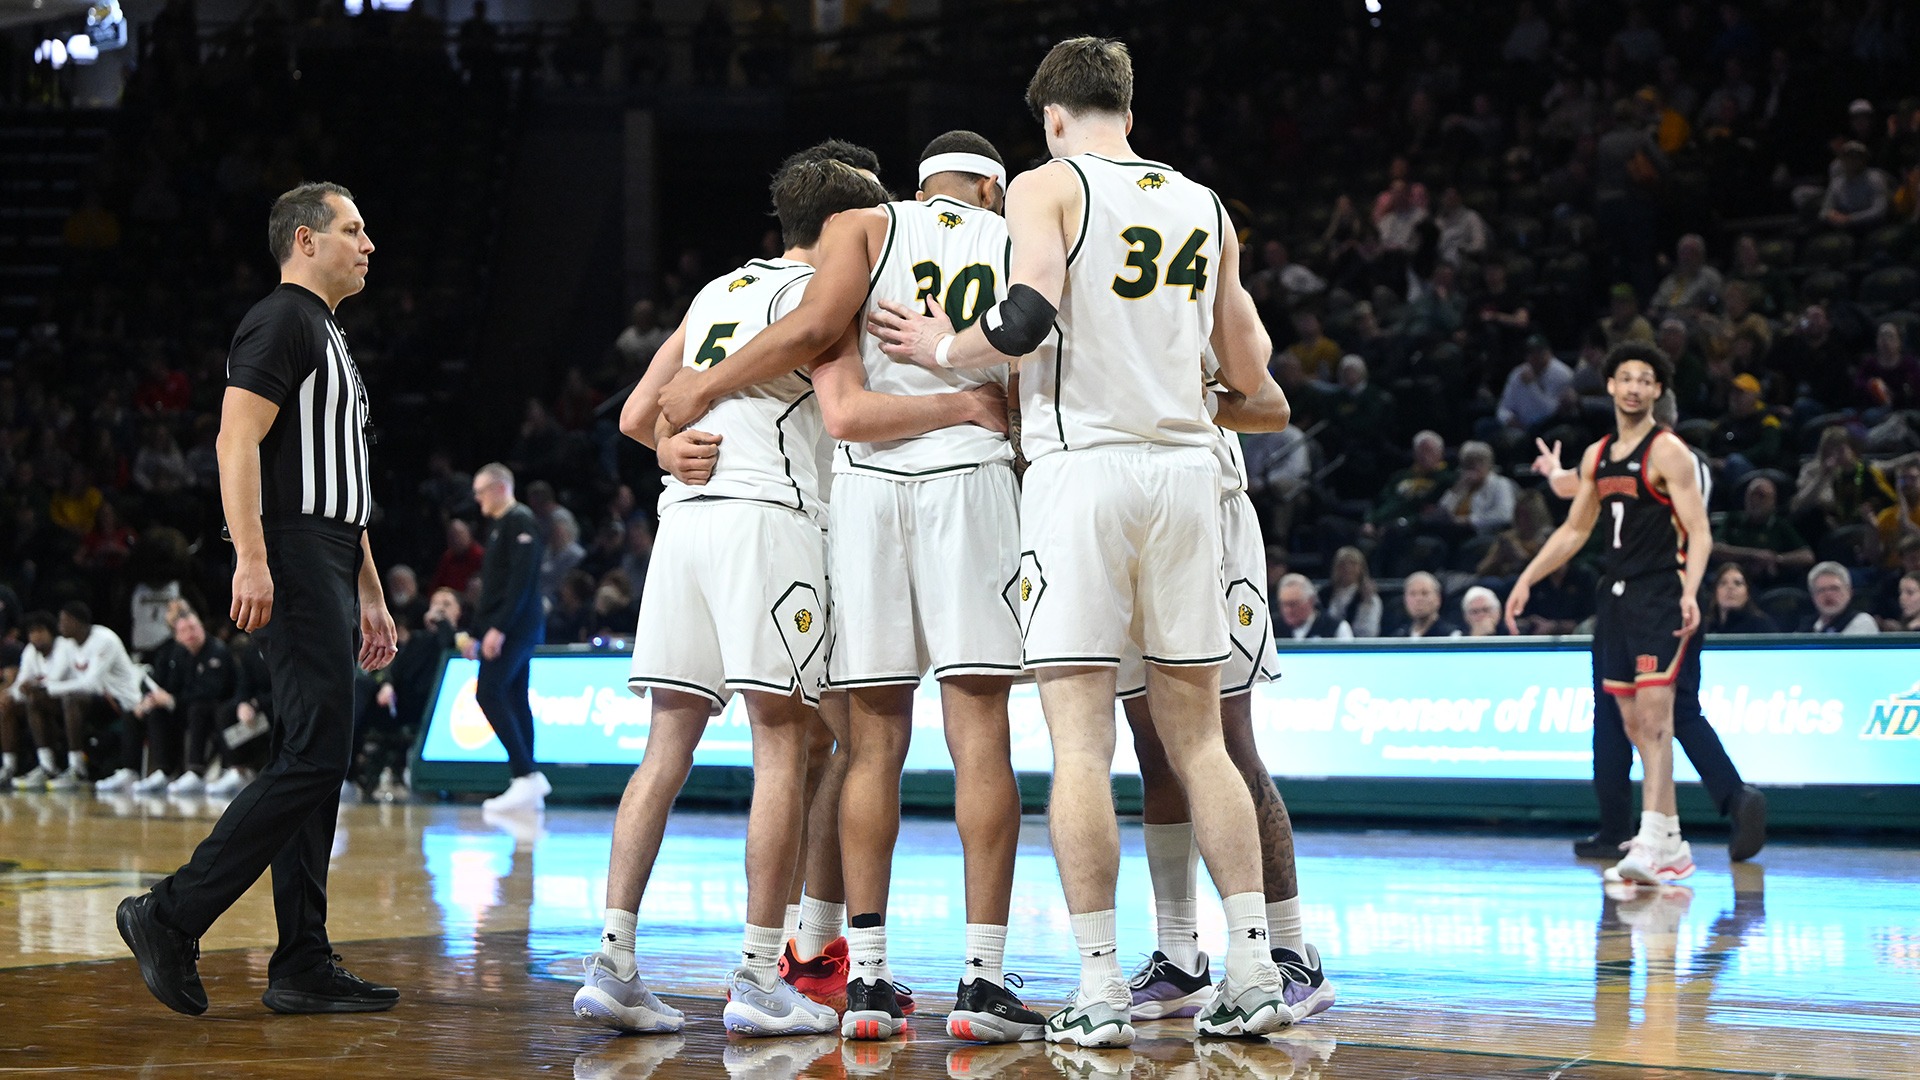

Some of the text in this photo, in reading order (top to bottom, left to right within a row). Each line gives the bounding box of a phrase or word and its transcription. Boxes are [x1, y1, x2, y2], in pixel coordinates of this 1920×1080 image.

[1112, 225, 1210, 301] 34
[911, 259, 997, 334] 30
[694, 322, 740, 368] 5
[1611, 501, 1625, 549] 7
[1341, 686, 1491, 745] Sponsor
[1494, 685, 1540, 732] of
[1539, 686, 1594, 733] ND
